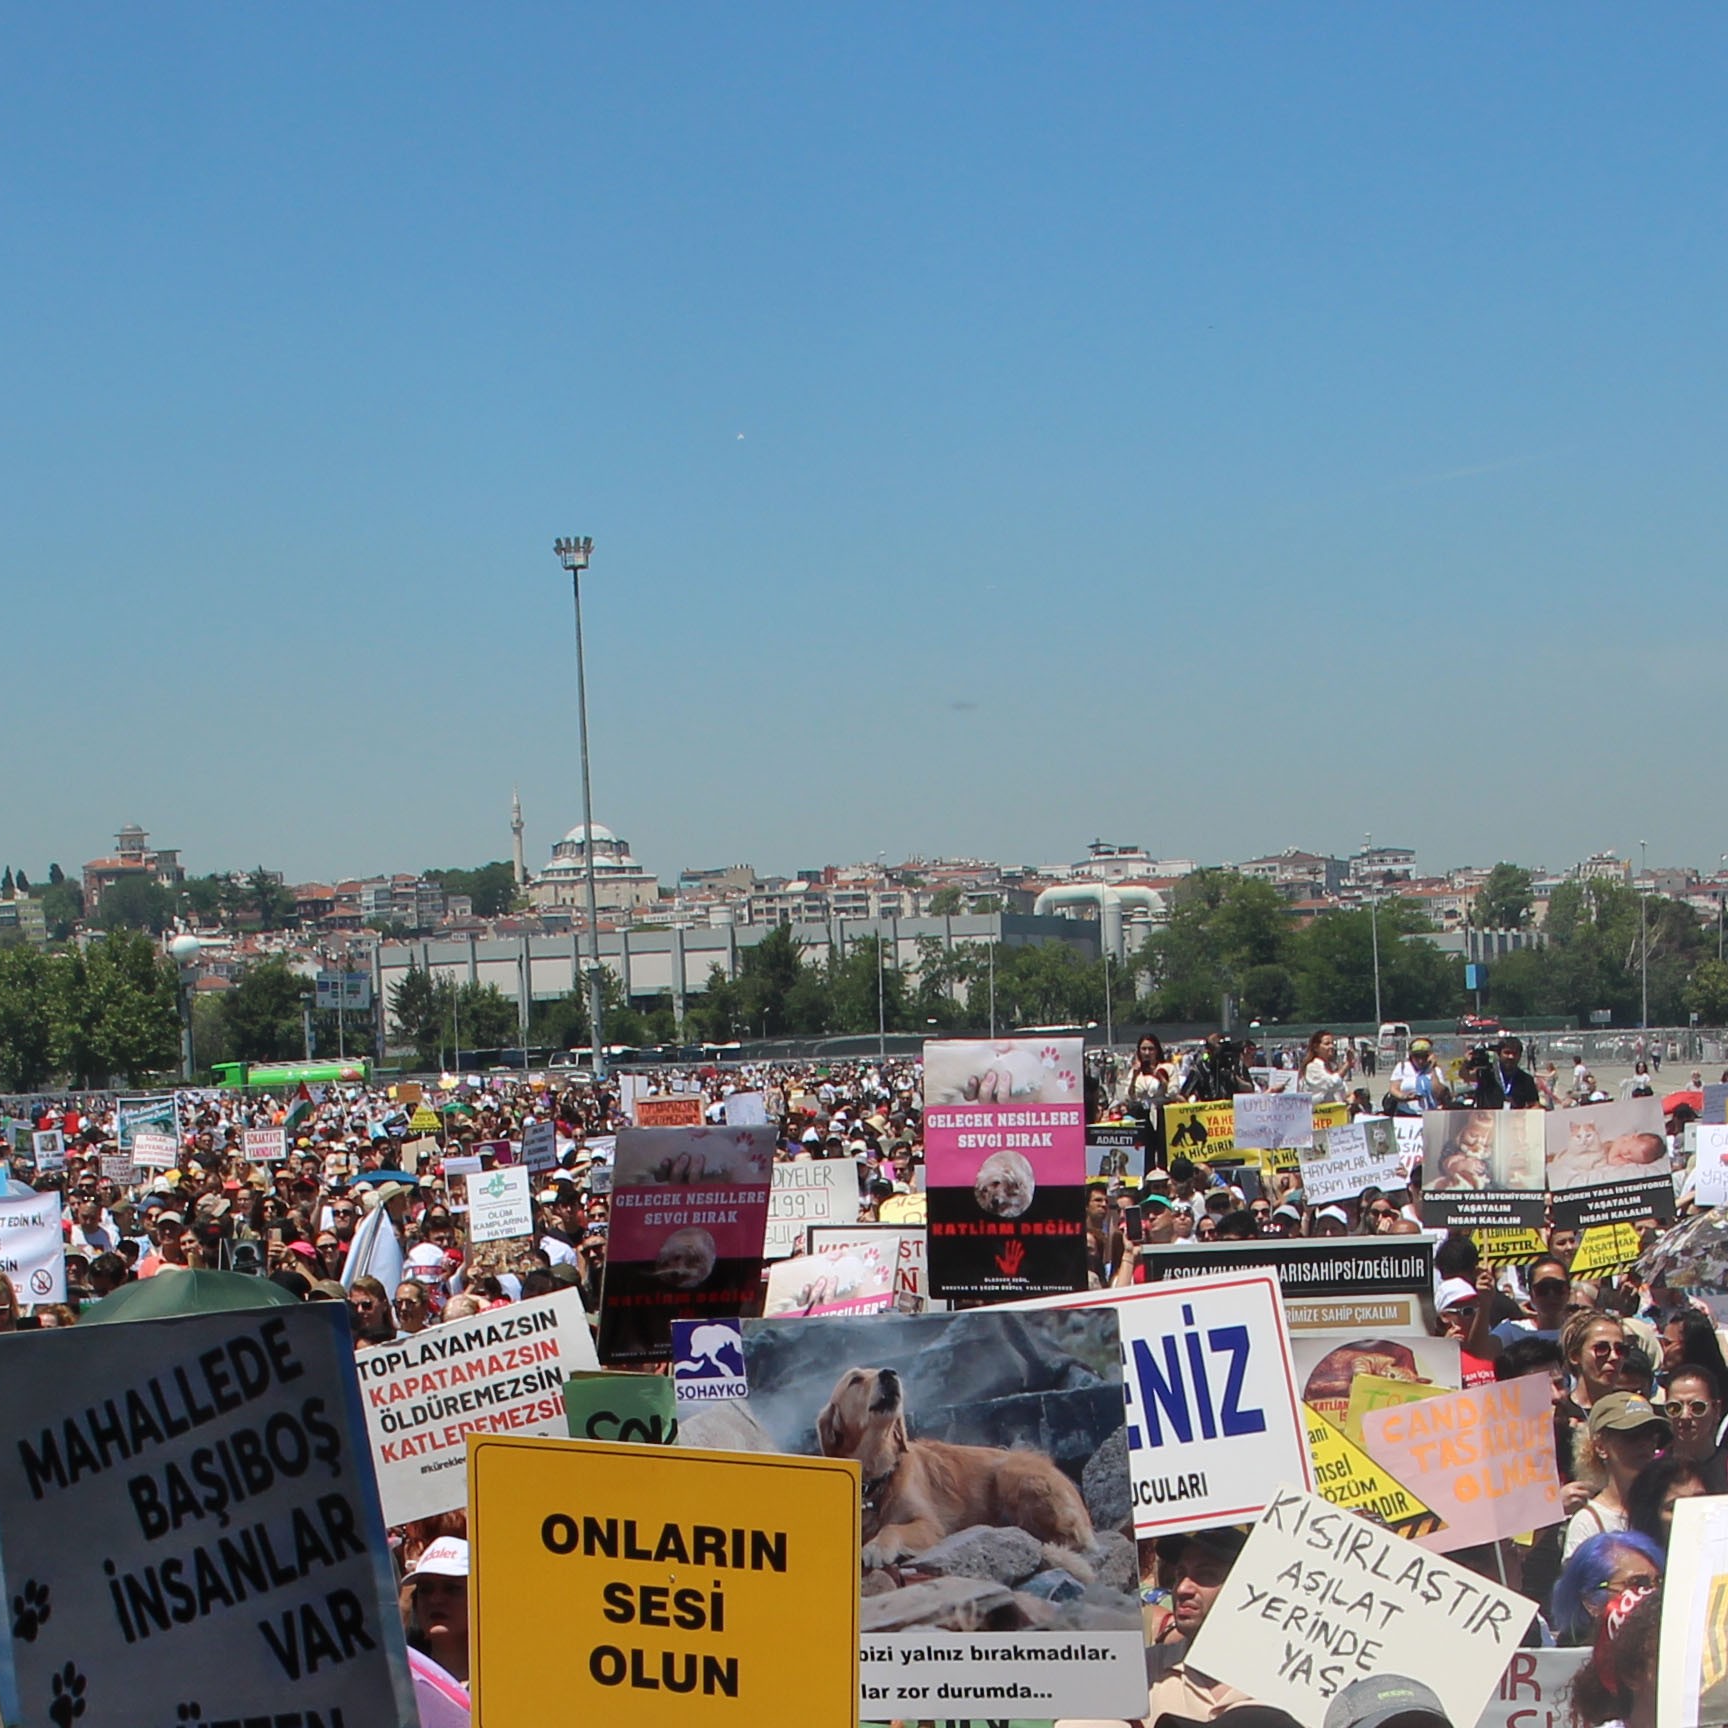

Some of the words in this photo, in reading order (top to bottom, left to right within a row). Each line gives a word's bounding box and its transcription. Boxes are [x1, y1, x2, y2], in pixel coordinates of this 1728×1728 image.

[247, 1133, 281, 1144] SOKAKTAYIZ
[928, 1114, 992, 1128] GELECEK
[997, 1112, 1079, 1127] NESİLLERE
[958, 1134, 1002, 1147] SEVGİ
[1006, 1134, 1053, 1146] BIRAK
[8, 1215, 29, 1227] EDİN
[32, 1215, 44, 1227] Kİ,
[488, 1209, 512, 1219] ÖLÜM
[1424, 1192, 1462, 1201] ÖLDÜREN
[1464, 1192, 1485, 1201] YASA
[1448, 1216, 1477, 1225] İNSAN
[1479, 1216, 1521, 1225] KALALIM
[1457, 1204, 1511, 1214] YAŞATALIM
[474, 1217, 529, 1230] KAMPLARINA
[932, 1220, 1015, 1235] KATLİAM
[1021, 1221, 1082, 1235] DEĞİL!
[355, 1308, 559, 1381] TOPLAYAMAZSIN
[368, 1338, 560, 1408] KAPATAMAZSIN
[676, 1383, 746, 1399] SOHAYKO
[17, 1316, 304, 1500] MAHALLEDE
[380, 1365, 563, 1434] ÖLDÜREMEZSİN
[126, 1397, 342, 1541] BAŞIBOŞ
[103, 1491, 368, 1645] İNSANLAR
[541, 1513, 788, 1573] ONLARIN
[1263, 1488, 1513, 1644] KISIRLAŞTIR
[603, 1580, 724, 1632] SESİ
[1276, 1559, 1404, 1630] AŞILAT
[259, 1587, 377, 1681] VAR
[1237, 1584, 1383, 1669] YERİNDE
[589, 1645, 739, 1698] OLUN
